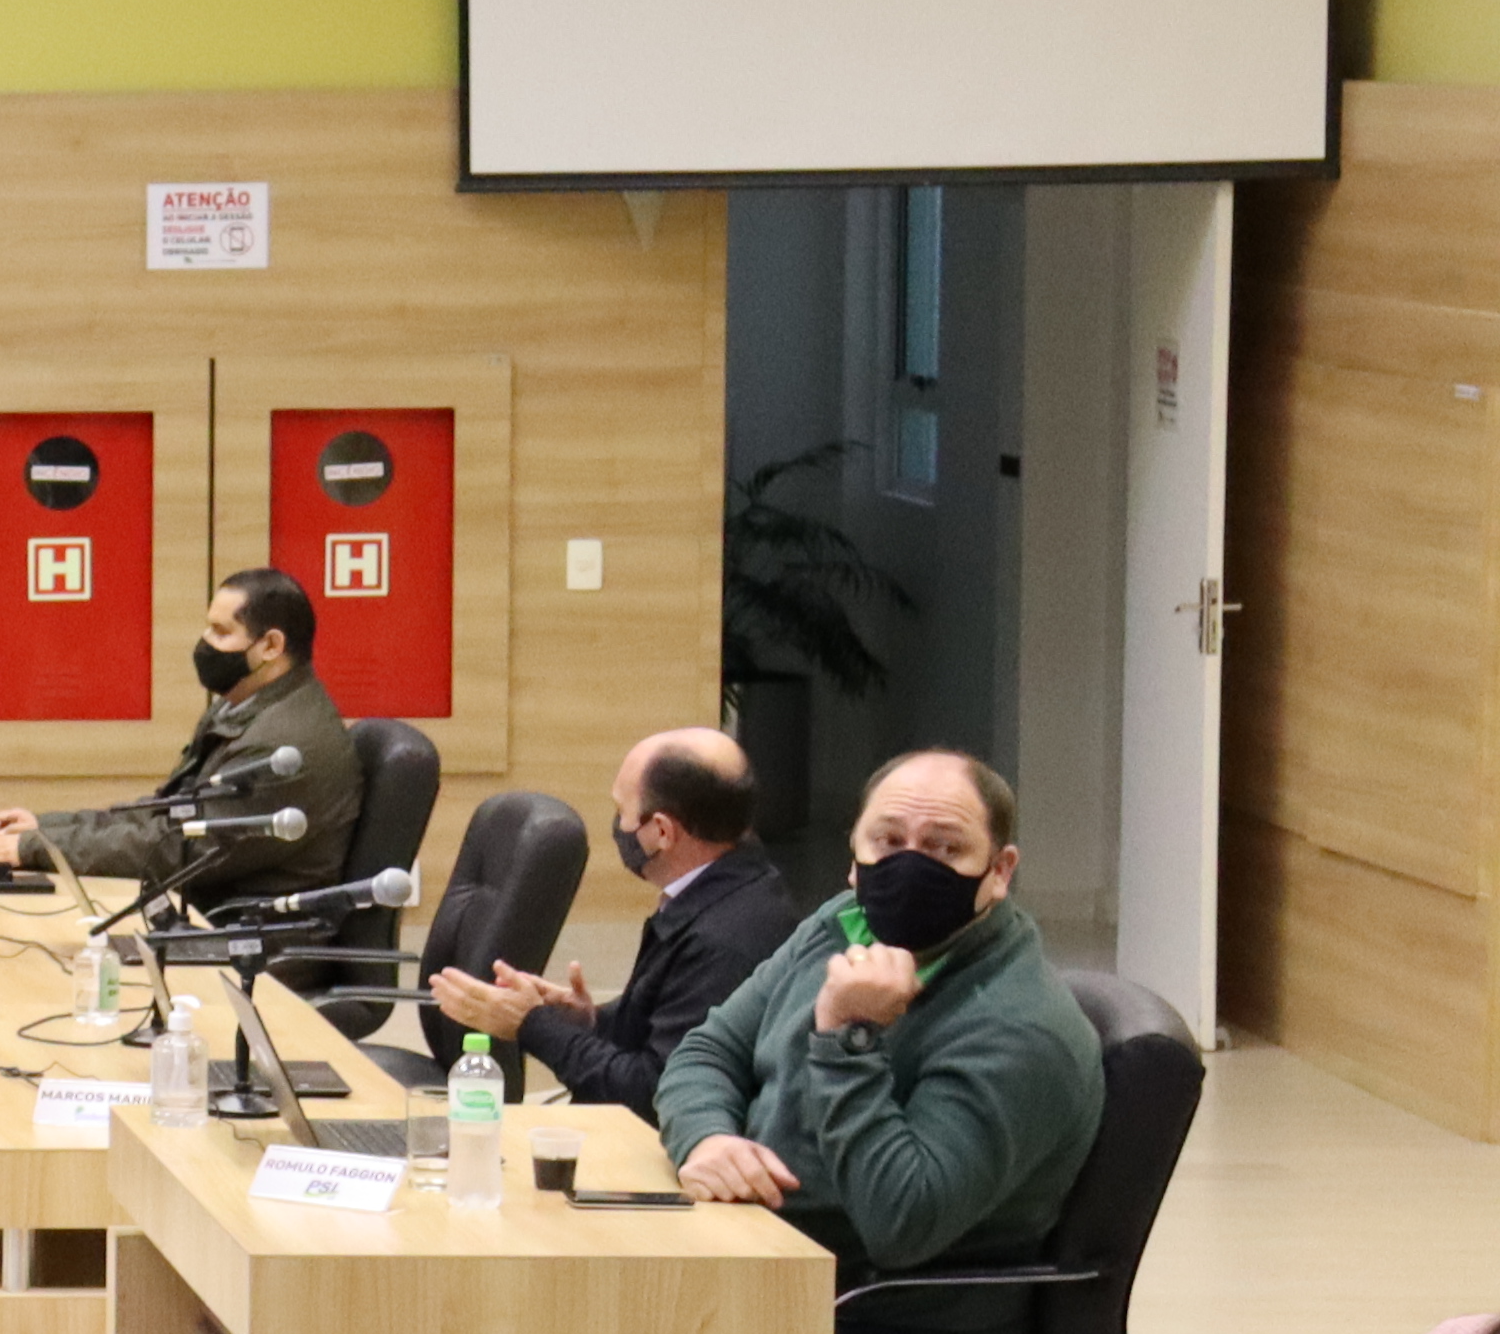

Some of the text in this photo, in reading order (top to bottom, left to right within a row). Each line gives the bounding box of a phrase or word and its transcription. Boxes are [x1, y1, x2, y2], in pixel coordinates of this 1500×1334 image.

[164, 187, 251, 211] ATENÇÃO
[37, 547, 82, 591] H
[333, 543, 378, 588] H
[41, 1090, 151, 1105] MARCOS MARI
[265, 1158, 397, 1182] ROMULO FAGGION
[305, 1180, 339, 1194] PSL
